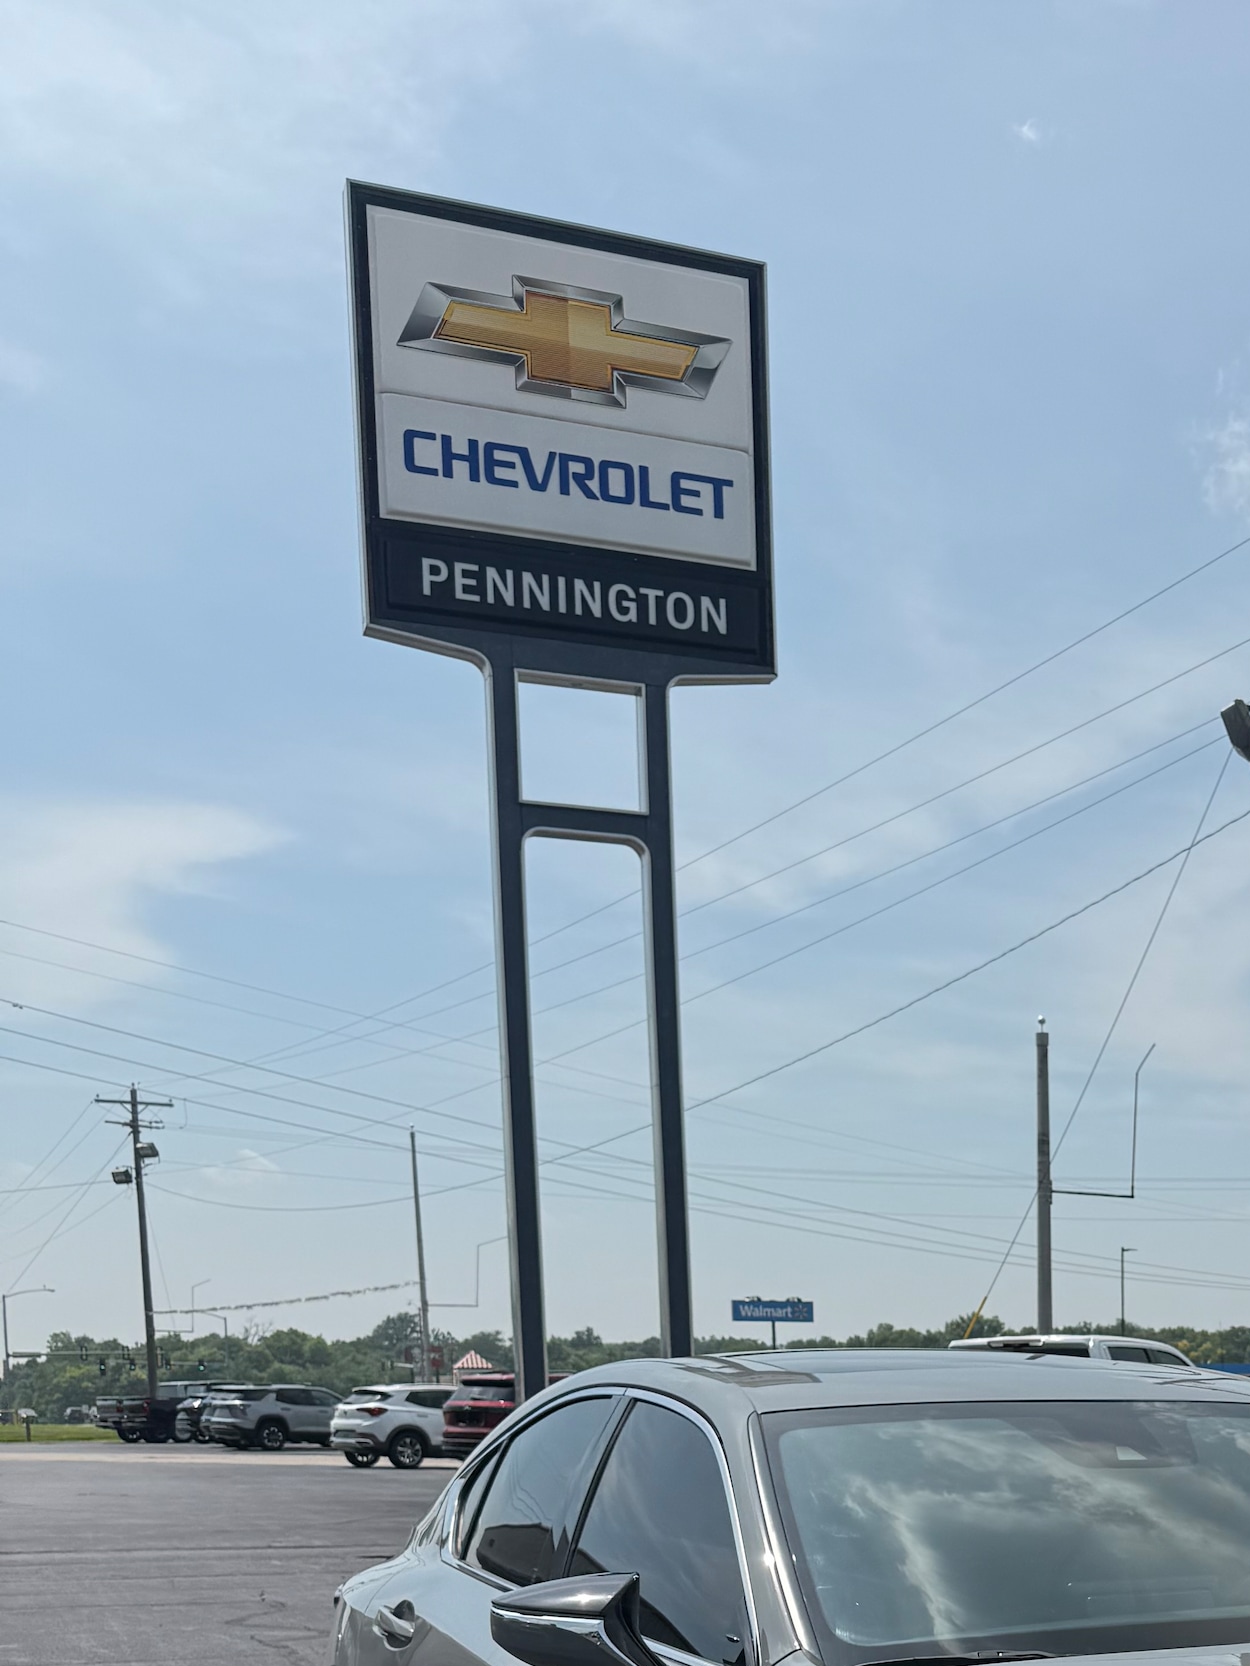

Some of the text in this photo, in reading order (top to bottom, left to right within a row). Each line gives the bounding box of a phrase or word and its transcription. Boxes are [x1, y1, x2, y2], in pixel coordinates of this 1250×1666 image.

[403, 429, 734, 520] CHEVROLET
[421, 557, 728, 635] PENNINGTON
[739, 1305, 793, 1318] Walmart
